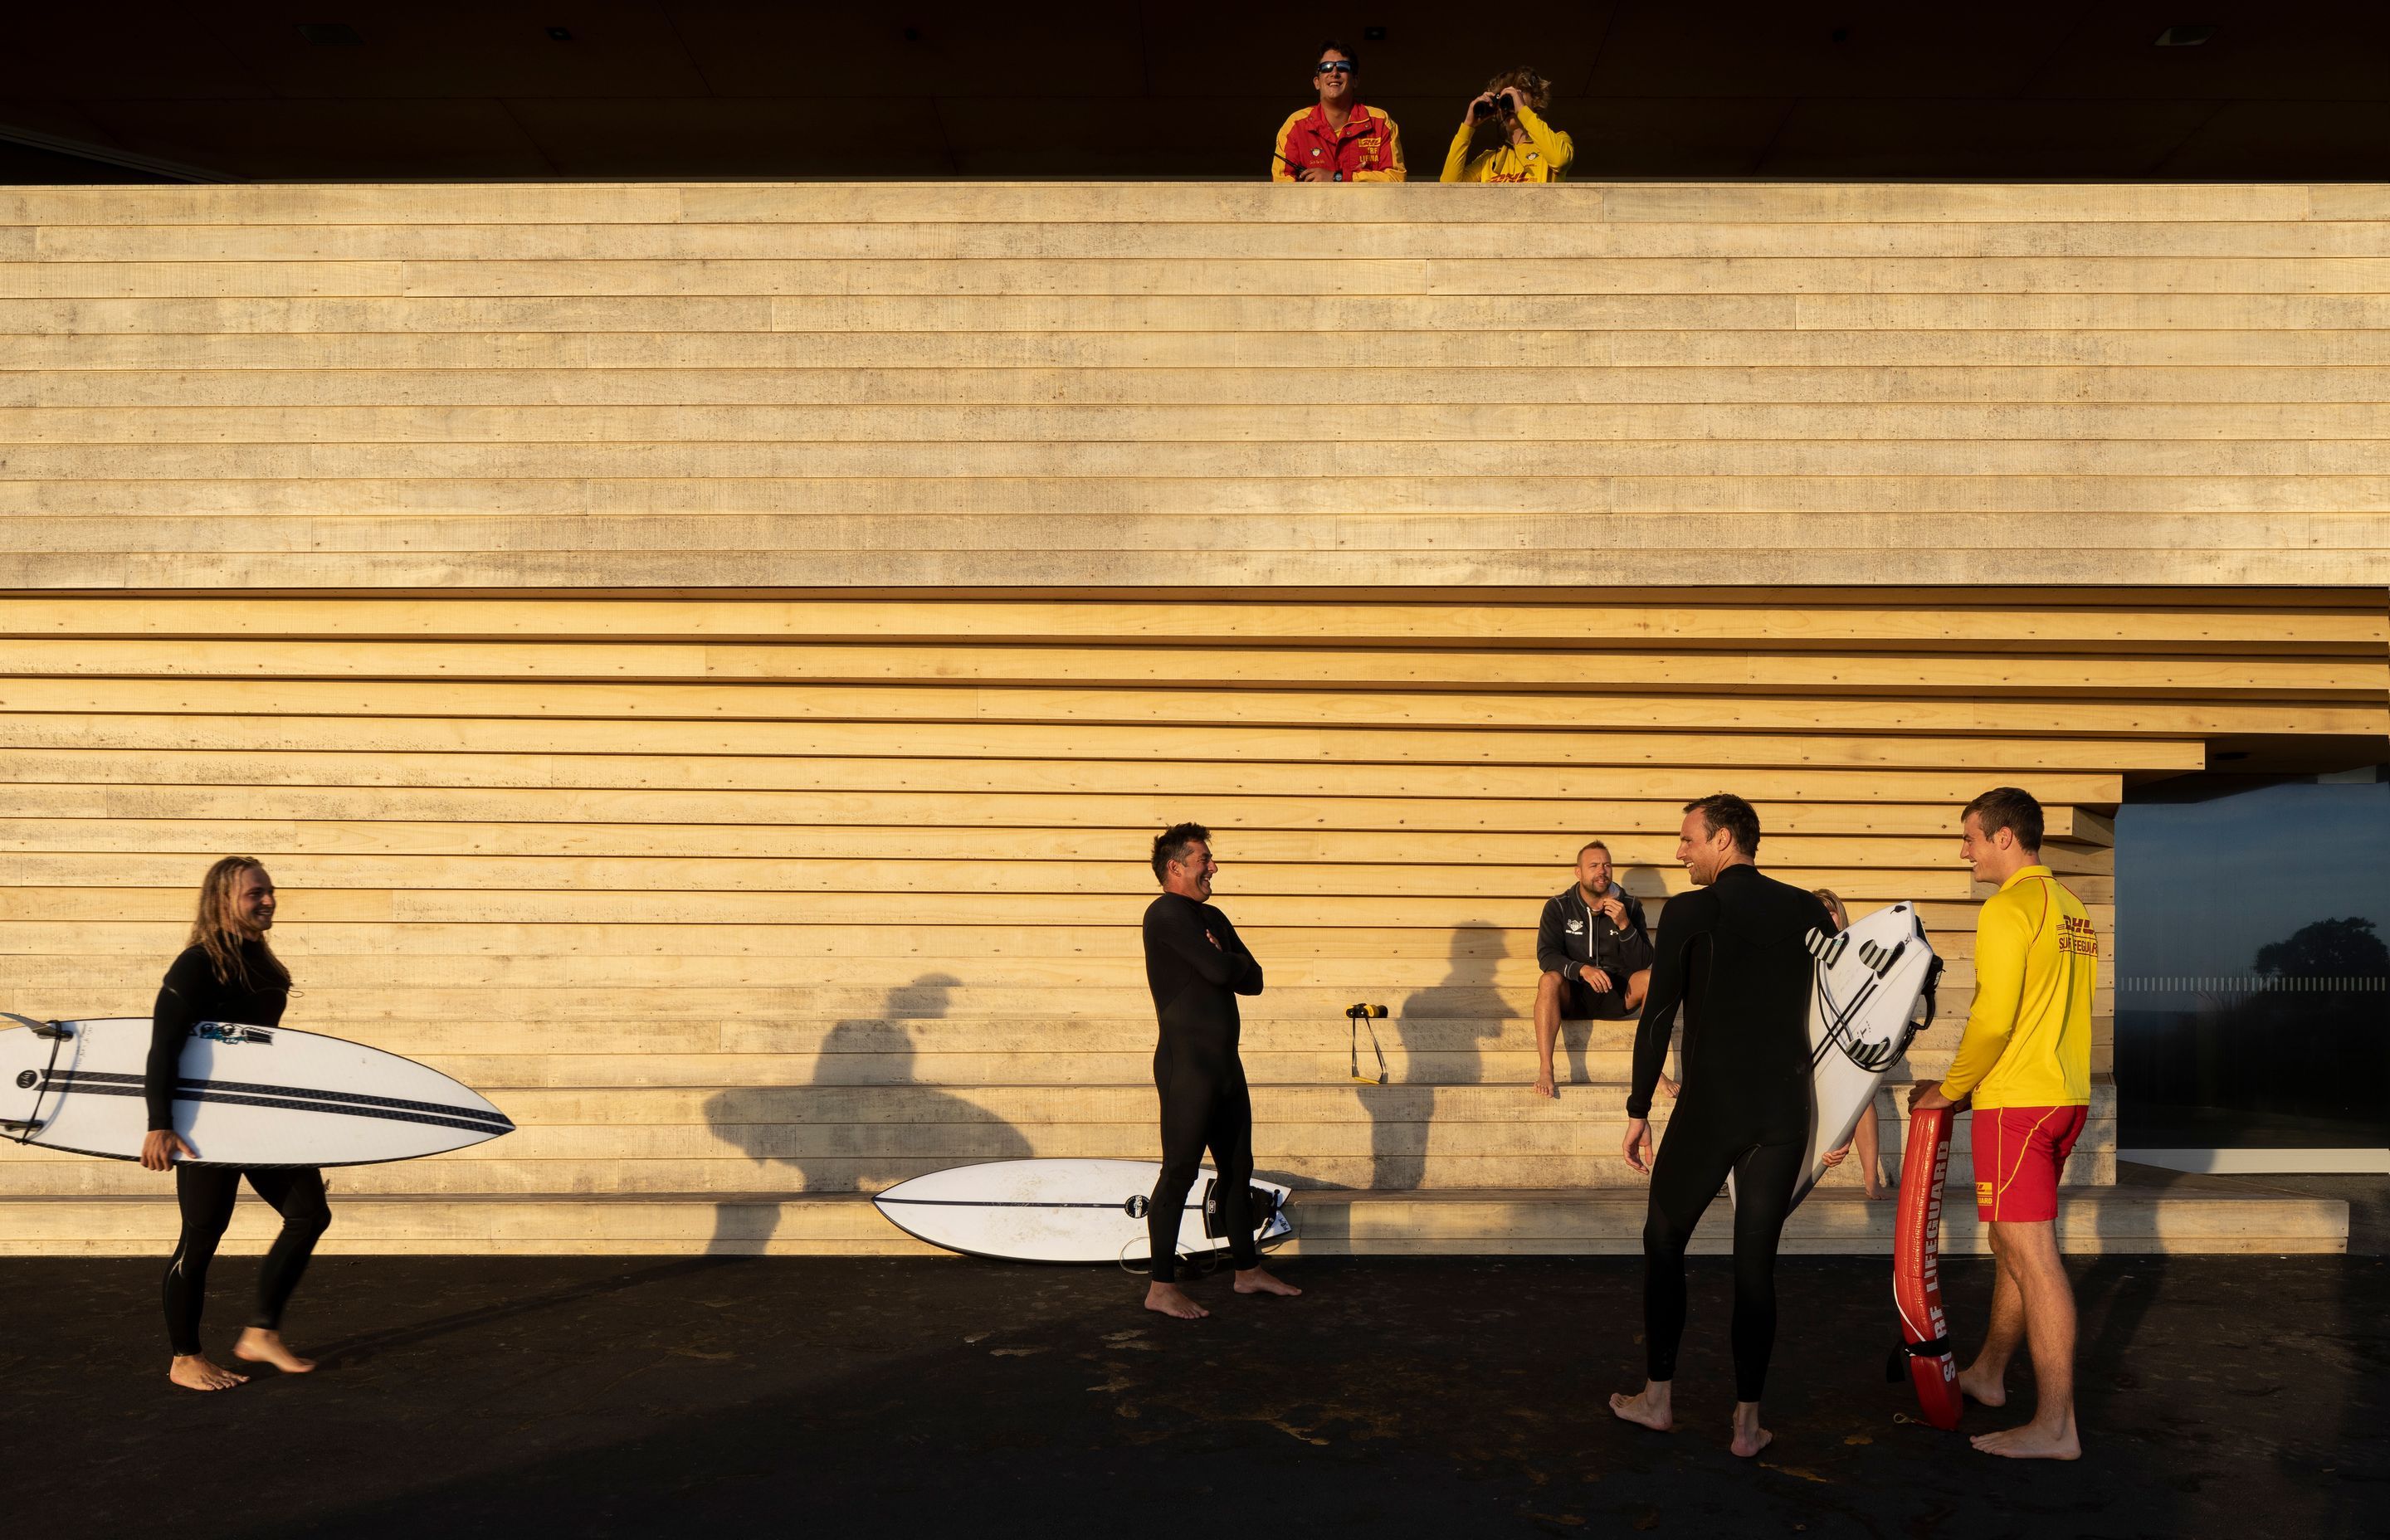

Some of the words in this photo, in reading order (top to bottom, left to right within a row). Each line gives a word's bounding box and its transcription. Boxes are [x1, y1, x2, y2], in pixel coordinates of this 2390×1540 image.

[1490, 173, 1529, 183] DHL
[2063, 914, 2095, 935] DHL
[1924, 1141, 1949, 1293] LIFEGUARD
